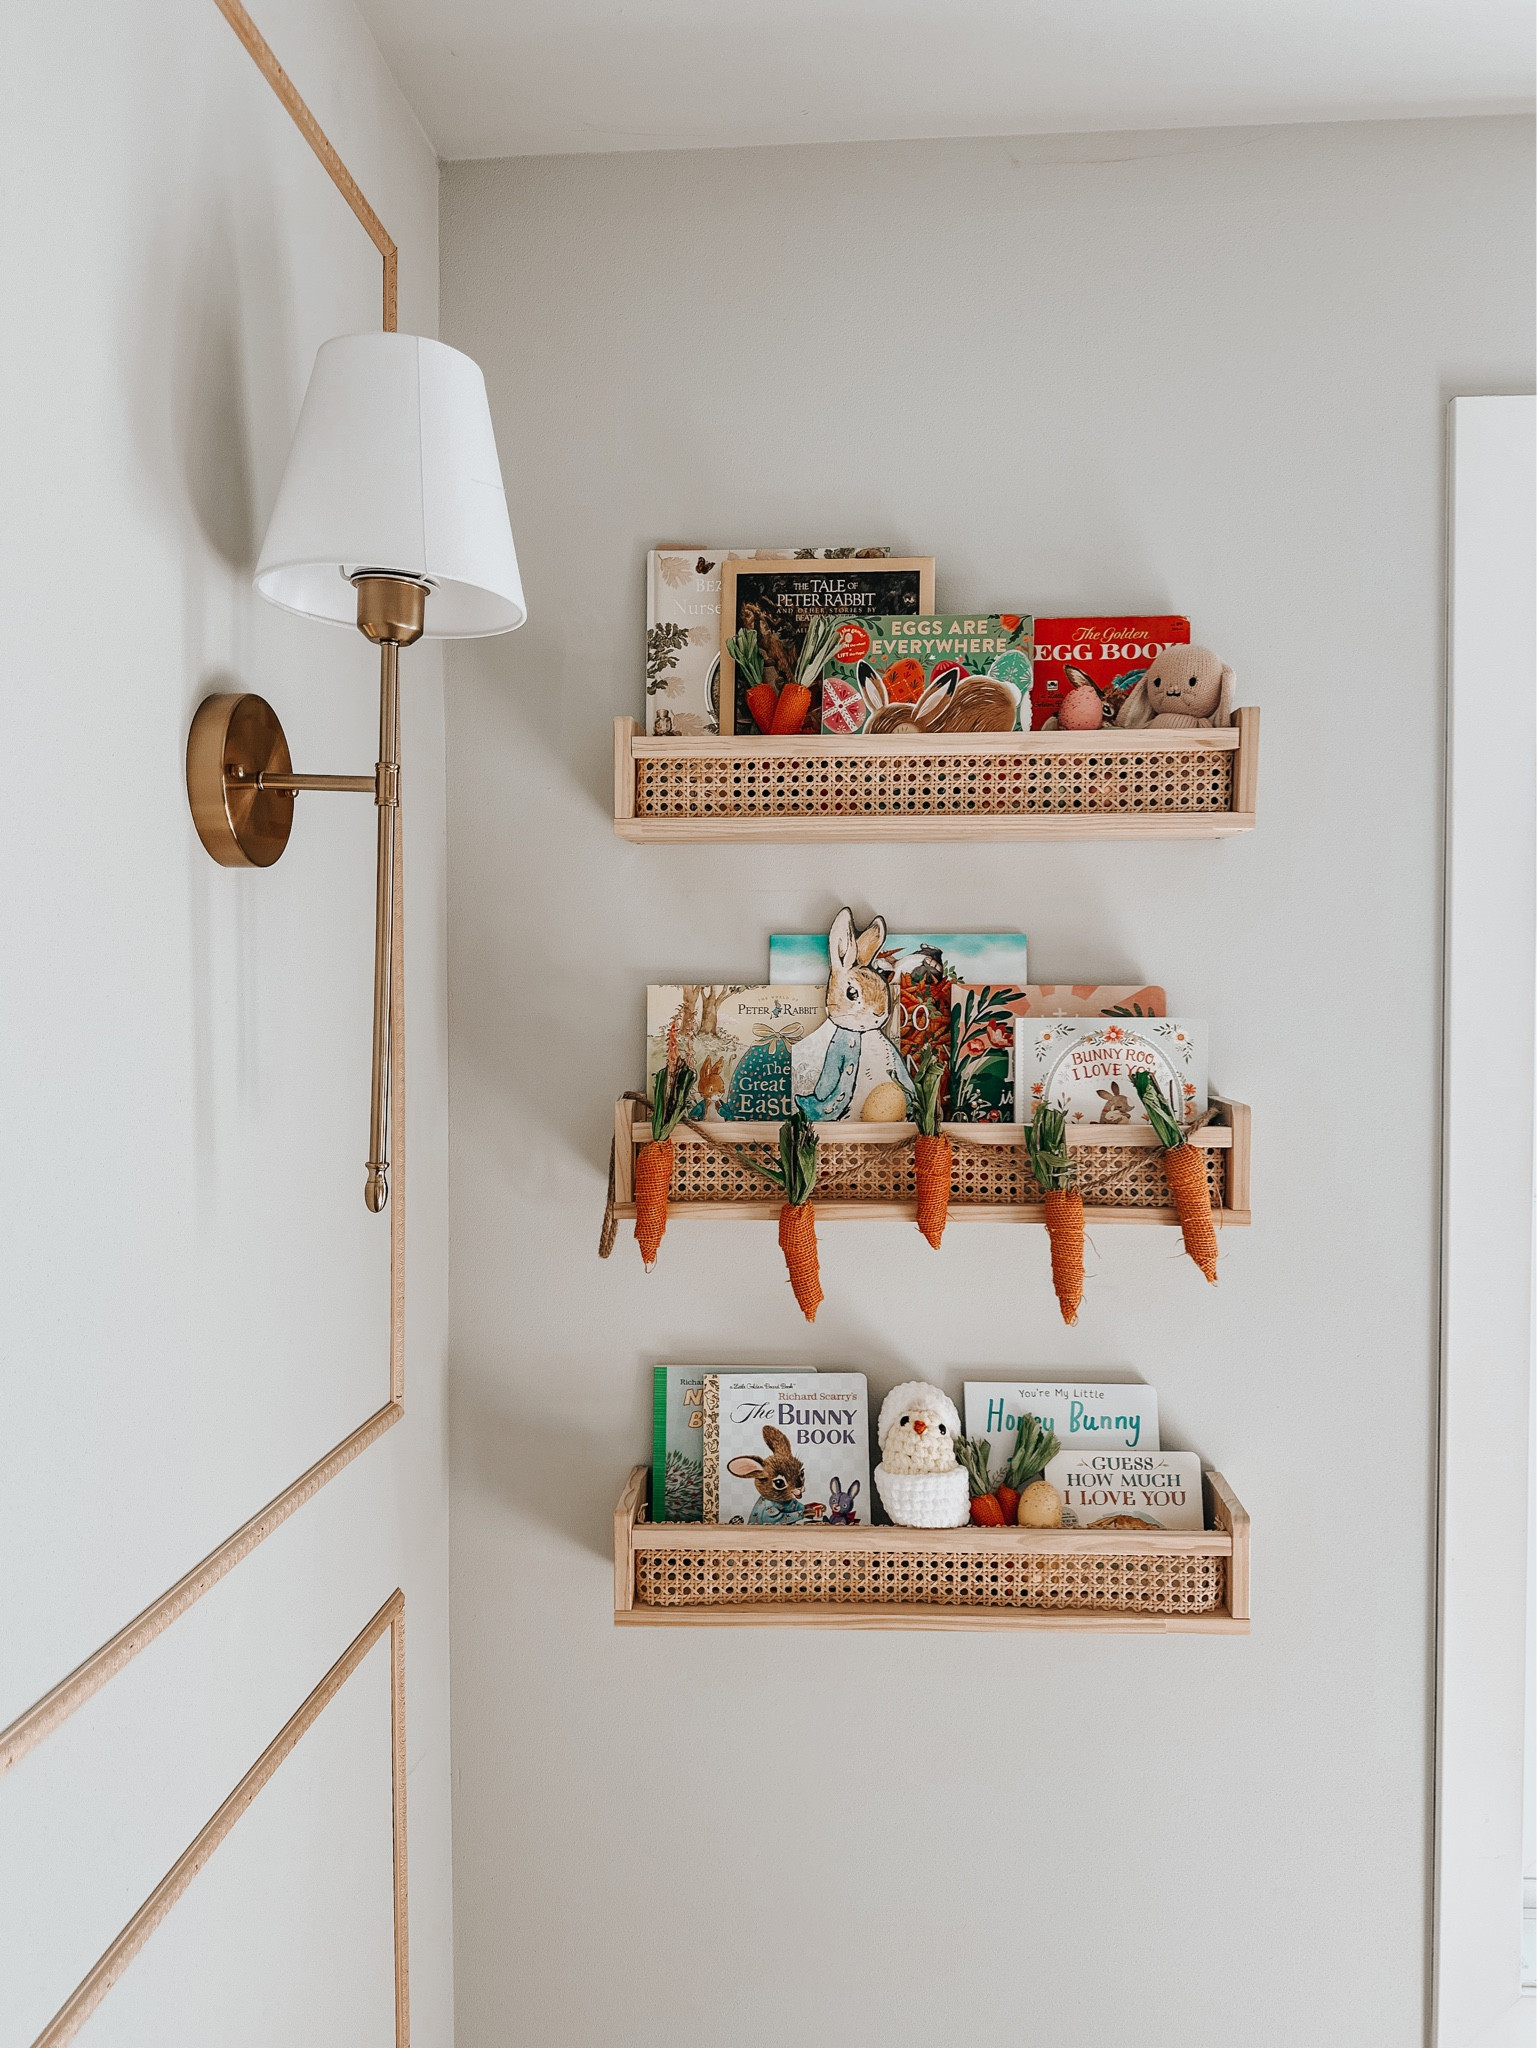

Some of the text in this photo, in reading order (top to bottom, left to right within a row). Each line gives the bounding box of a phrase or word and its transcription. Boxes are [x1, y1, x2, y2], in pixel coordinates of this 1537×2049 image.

[793, 580, 859, 592] THE TALE OF
[673, 599, 722, 615] Nurse
[776, 592, 876, 606] PETER RABBIT
[891, 620, 988, 636] EGGS ARE
[1072, 626, 1150, 643] The Golden
[872, 638, 1007, 655] EVERYWHERE
[1034, 642, 1185, 660] EGG BOO
[738, 1004, 818, 1016] PETER RABBIT
[1071, 1048, 1156, 1066] BUNNY ROO,
[762, 1061, 791, 1076] The
[1072, 1068, 1080, 1080] I
[1083, 1063, 1122, 1078] LOVE
[739, 1077, 786, 1092] Great
[738, 1094, 792, 1116] East
[778, 1392, 858, 1402] Richard Scarry's
[1018, 1388, 1104, 1399] You're My Little
[730, 1402, 776, 1424] The
[778, 1403, 858, 1425] BUNNY
[1070, 1400, 1140, 1447] Bunny
[796, 1429, 856, 1444] BOOK
[1092, 1456, 1154, 1471] GUESS
[1066, 1473, 1182, 1488] HOW MUCH
[1064, 1490, 1186, 1506] I LOVE YOU
